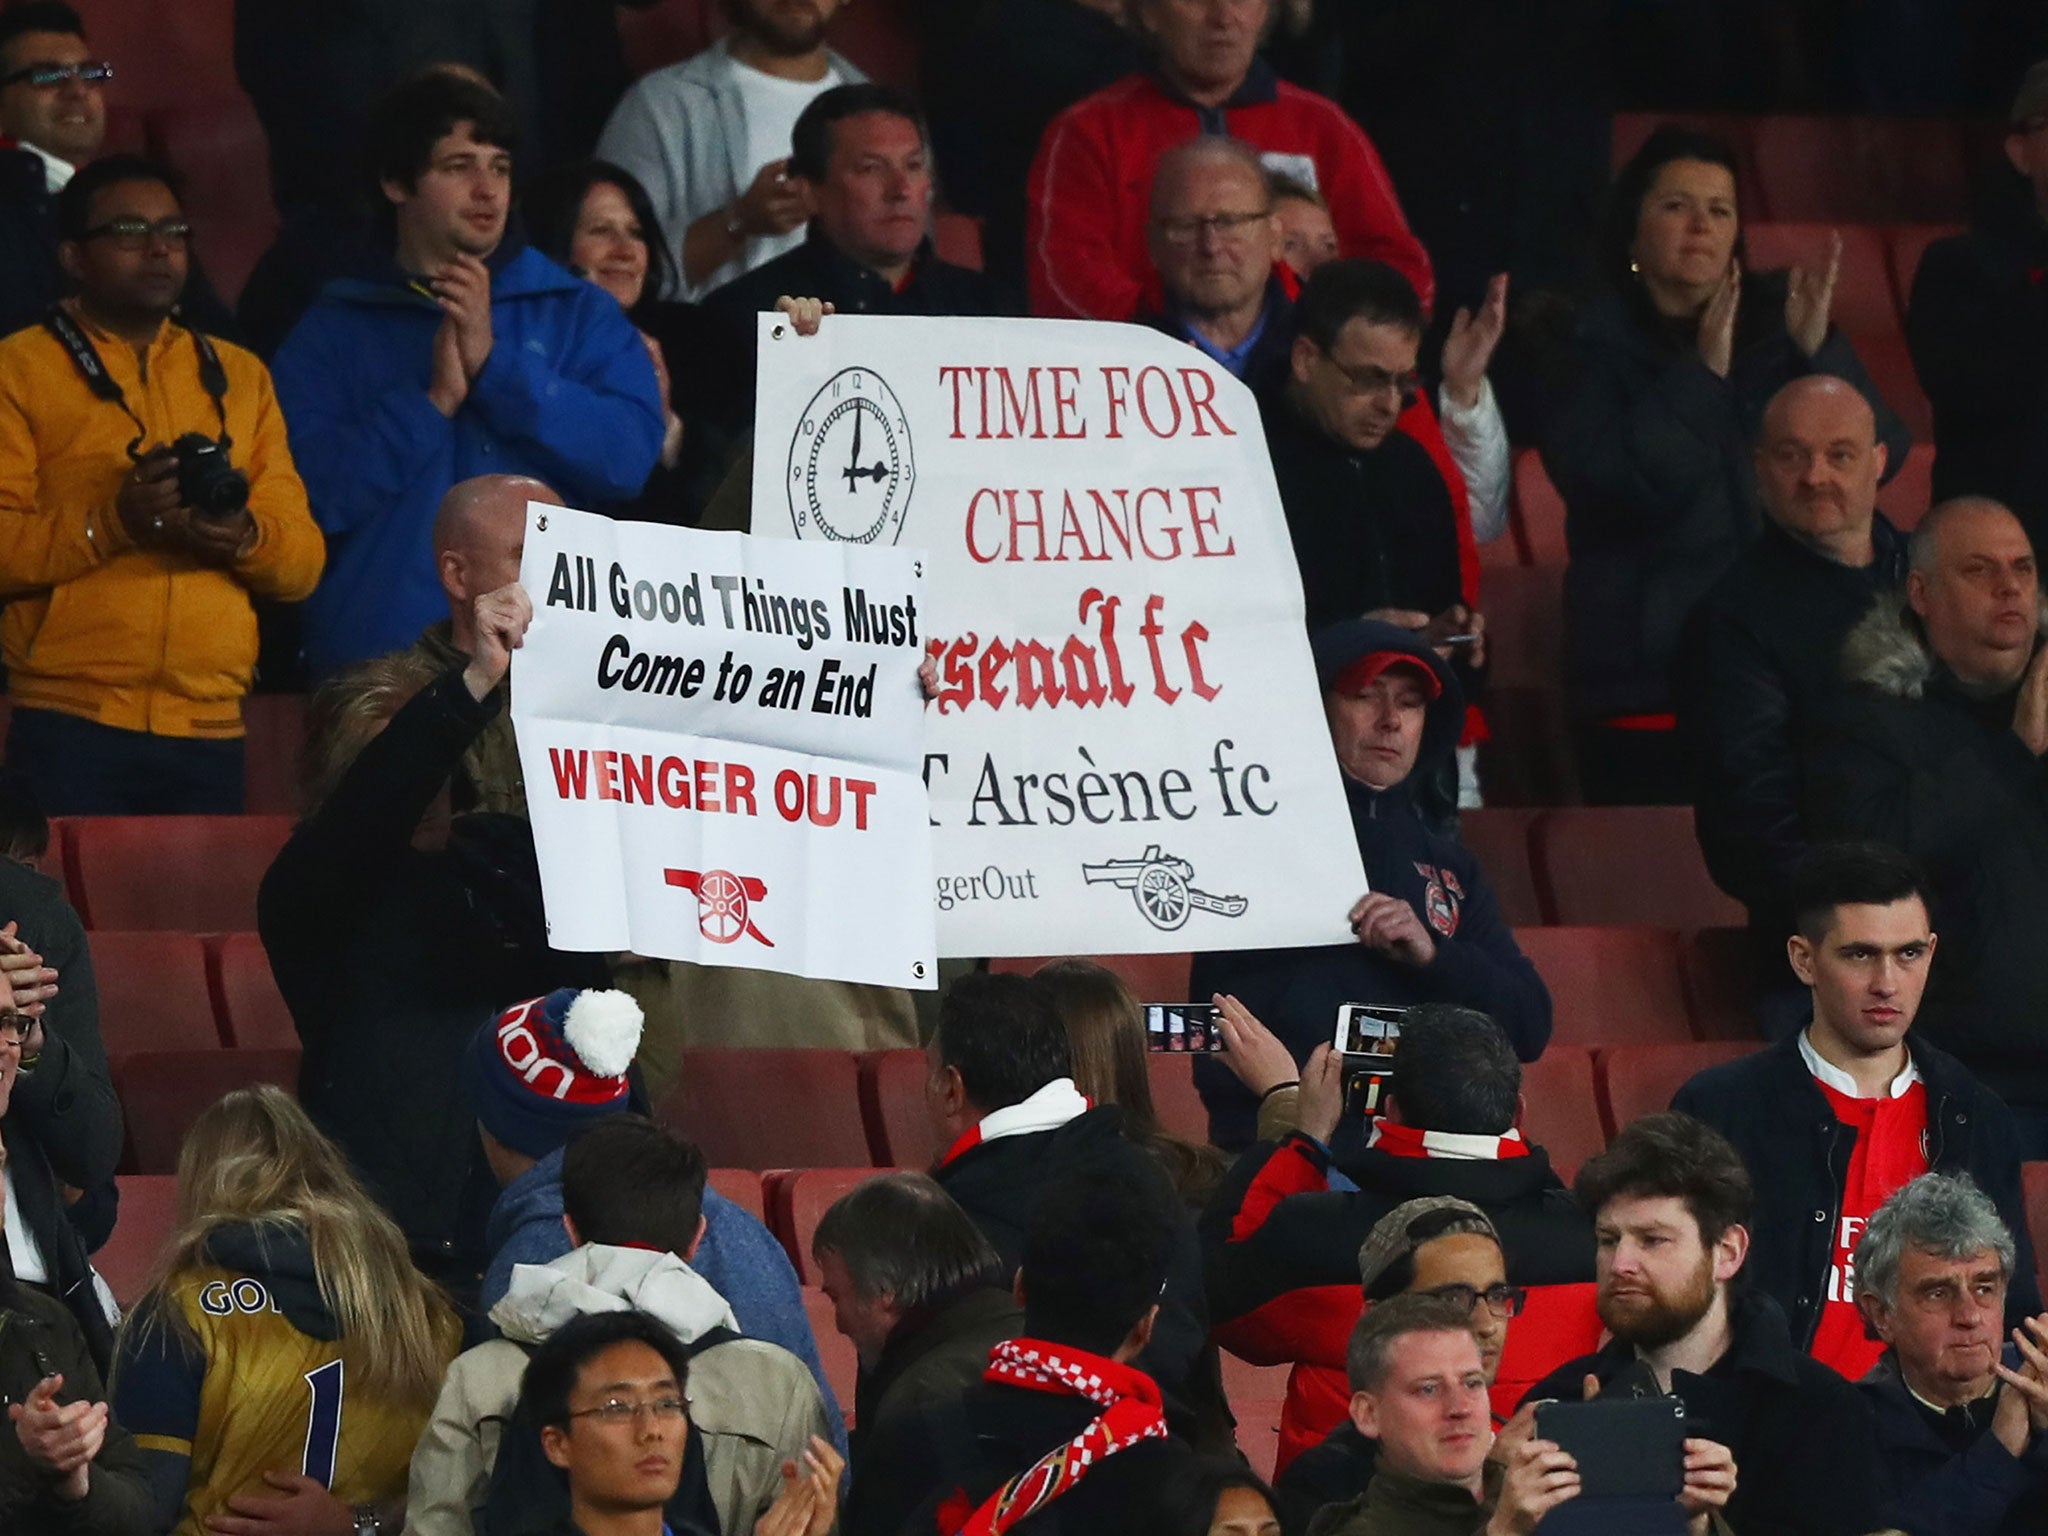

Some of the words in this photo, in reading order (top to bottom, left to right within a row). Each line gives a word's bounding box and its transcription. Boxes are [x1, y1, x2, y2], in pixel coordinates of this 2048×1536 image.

[897, 418, 905, 434] 2
[941, 366, 1087, 439] TIME
[1103, 366, 1235, 439] FOR
[792, 465, 802, 482] 9
[904, 464, 912, 482] 3
[797, 510, 807, 528] 8
[966, 487, 1235, 564] CHANGE
[547, 551, 597, 613] All
[609, 561, 706, 627] Good
[711, 575, 832, 651] Things
[843, 586, 919, 648] Must
[598, 633, 706, 699] Come
[713, 650, 754, 705] to
[758, 667, 806, 711] an
[811, 658, 878, 719] End
[549, 748, 757, 816] WENGER
[774, 769, 877, 831] OUT
[968, 745, 1198, 826] Arsène
[1210, 738, 1279, 817] fc
[934, 865, 1039, 911] gerOut
[199, 1277, 282, 1316] GO
